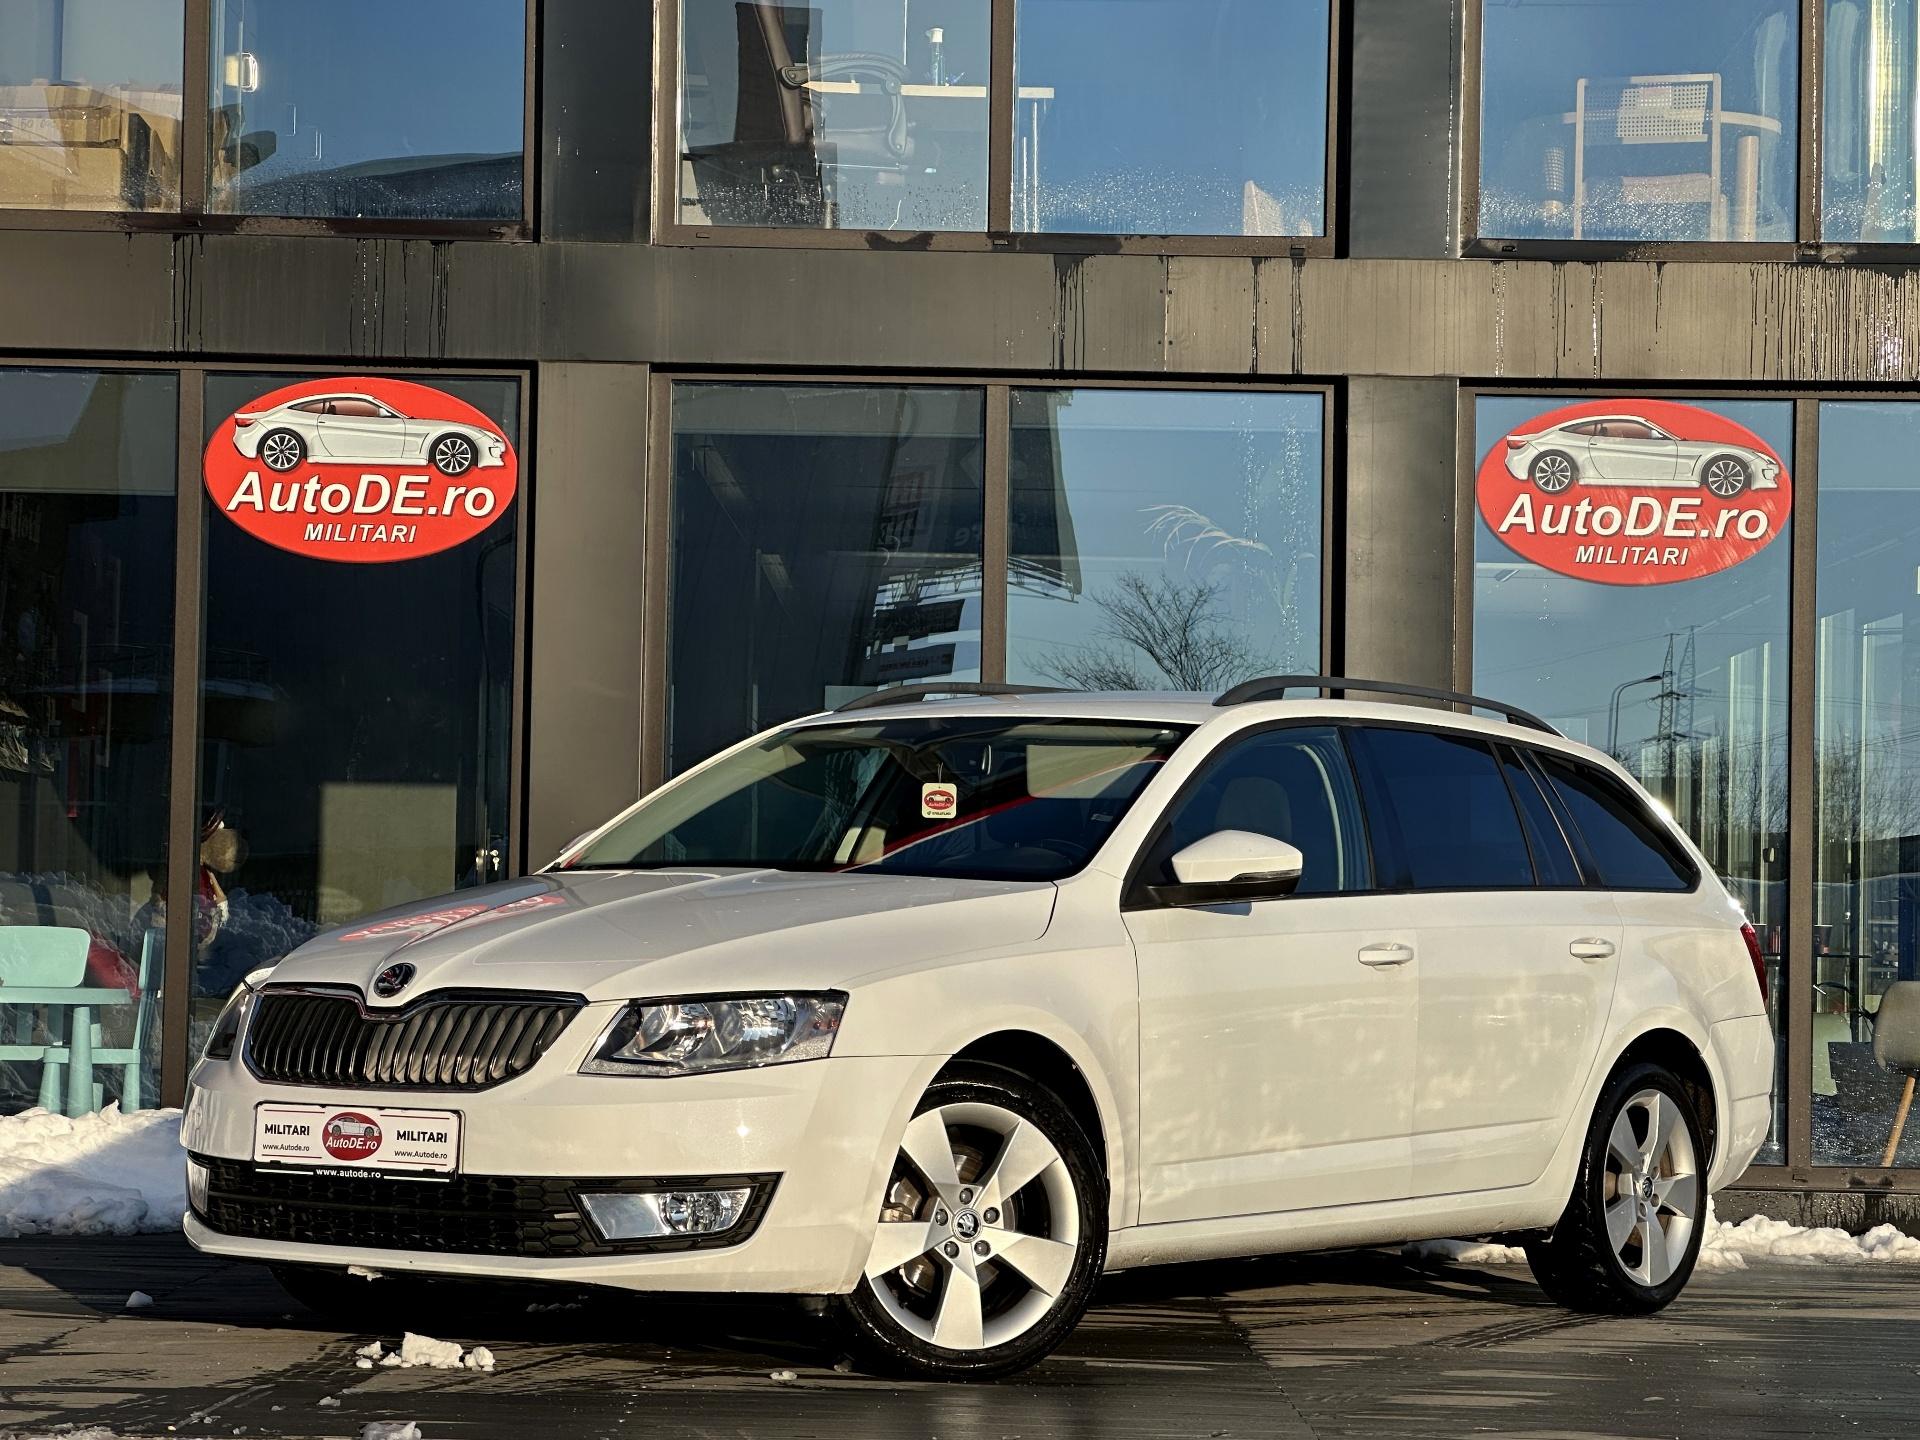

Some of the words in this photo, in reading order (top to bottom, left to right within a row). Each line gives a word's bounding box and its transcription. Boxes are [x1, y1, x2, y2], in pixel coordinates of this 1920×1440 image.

[226, 471, 496, 518] AutoDE.ro
[1498, 493, 1769, 540] AutoDE.ro
[303, 523, 418, 544] MILITARI
[1574, 545, 1689, 566] MILITARI
[264, 1123, 310, 1136] MILITARI
[396, 1130, 448, 1143] MILITARI
[262, 1143, 310, 1152] www.Autode.ro
[326, 1137, 378, 1150] AutoDE.ro
[394, 1150, 448, 1160] www.Autode.ro
[316, 1168, 381, 1179] www.autode.ro
